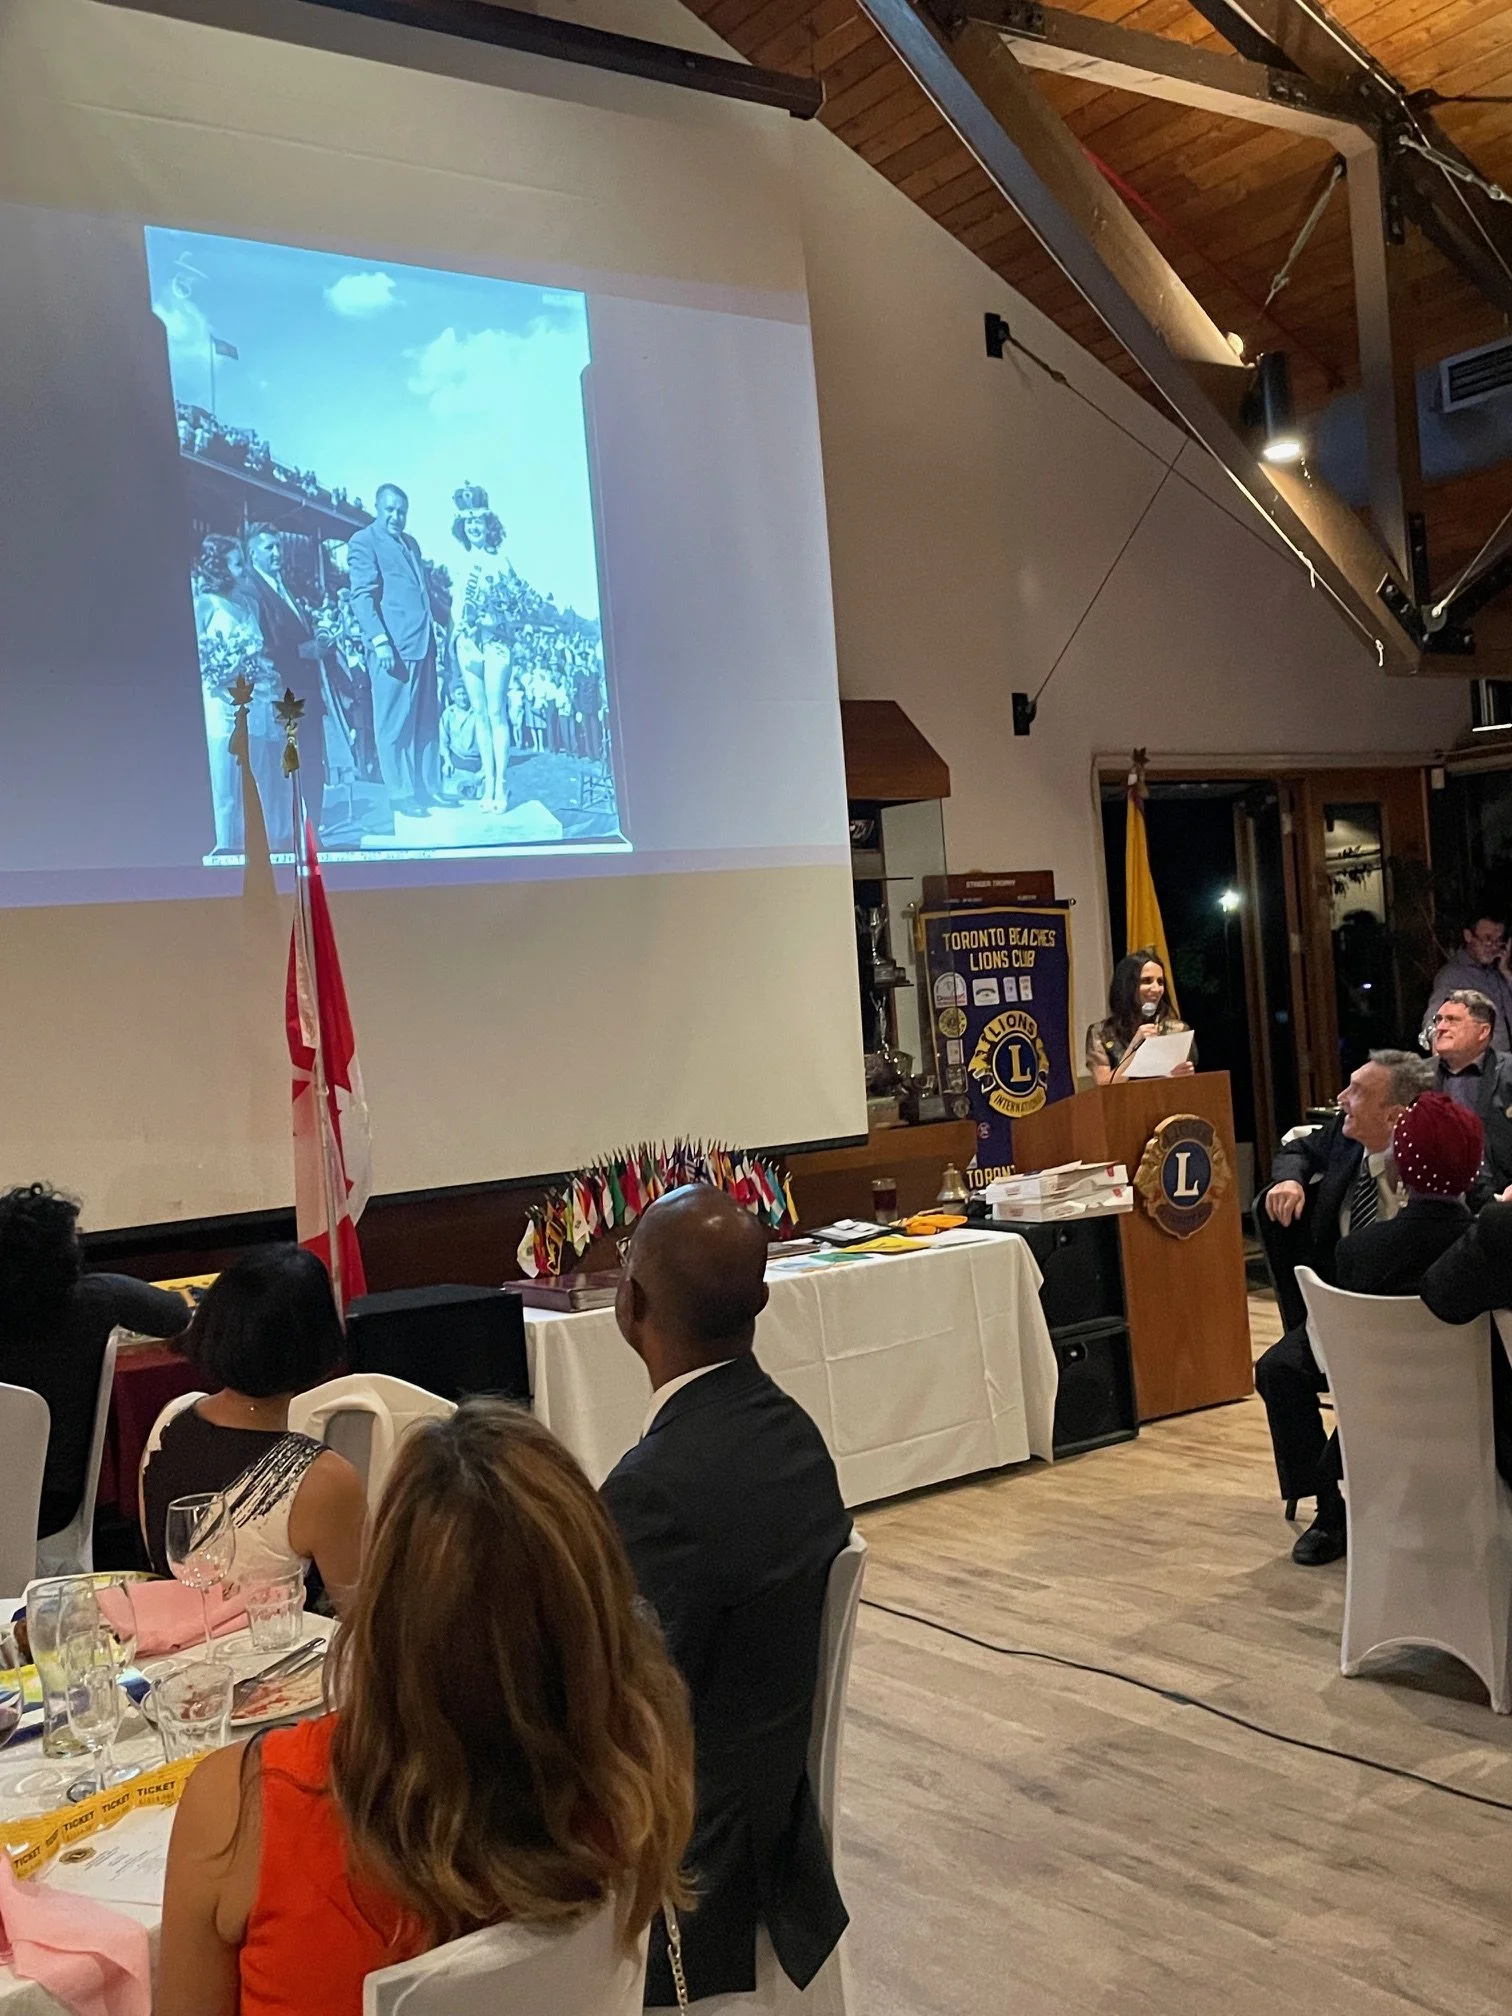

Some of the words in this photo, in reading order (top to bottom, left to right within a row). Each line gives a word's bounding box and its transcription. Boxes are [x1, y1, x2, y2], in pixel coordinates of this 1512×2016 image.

[942, 928, 1005, 951] TORONTO
[1009, 928, 1056, 947] BEACHES
[970, 951, 1010, 971] LIONS
[1012, 950, 1036, 968] CLUB
[989, 1013, 1035, 1039] LIONS
[1008, 1044, 1032, 1083] L
[1173, 1152, 1199, 1197] L
[136, 1781, 175, 1797] TICKET
[101, 1793, 131, 1813] TICKET
[63, 1811, 95, 1832] TICKET
[13, 1845, 41, 1869] TICKET
